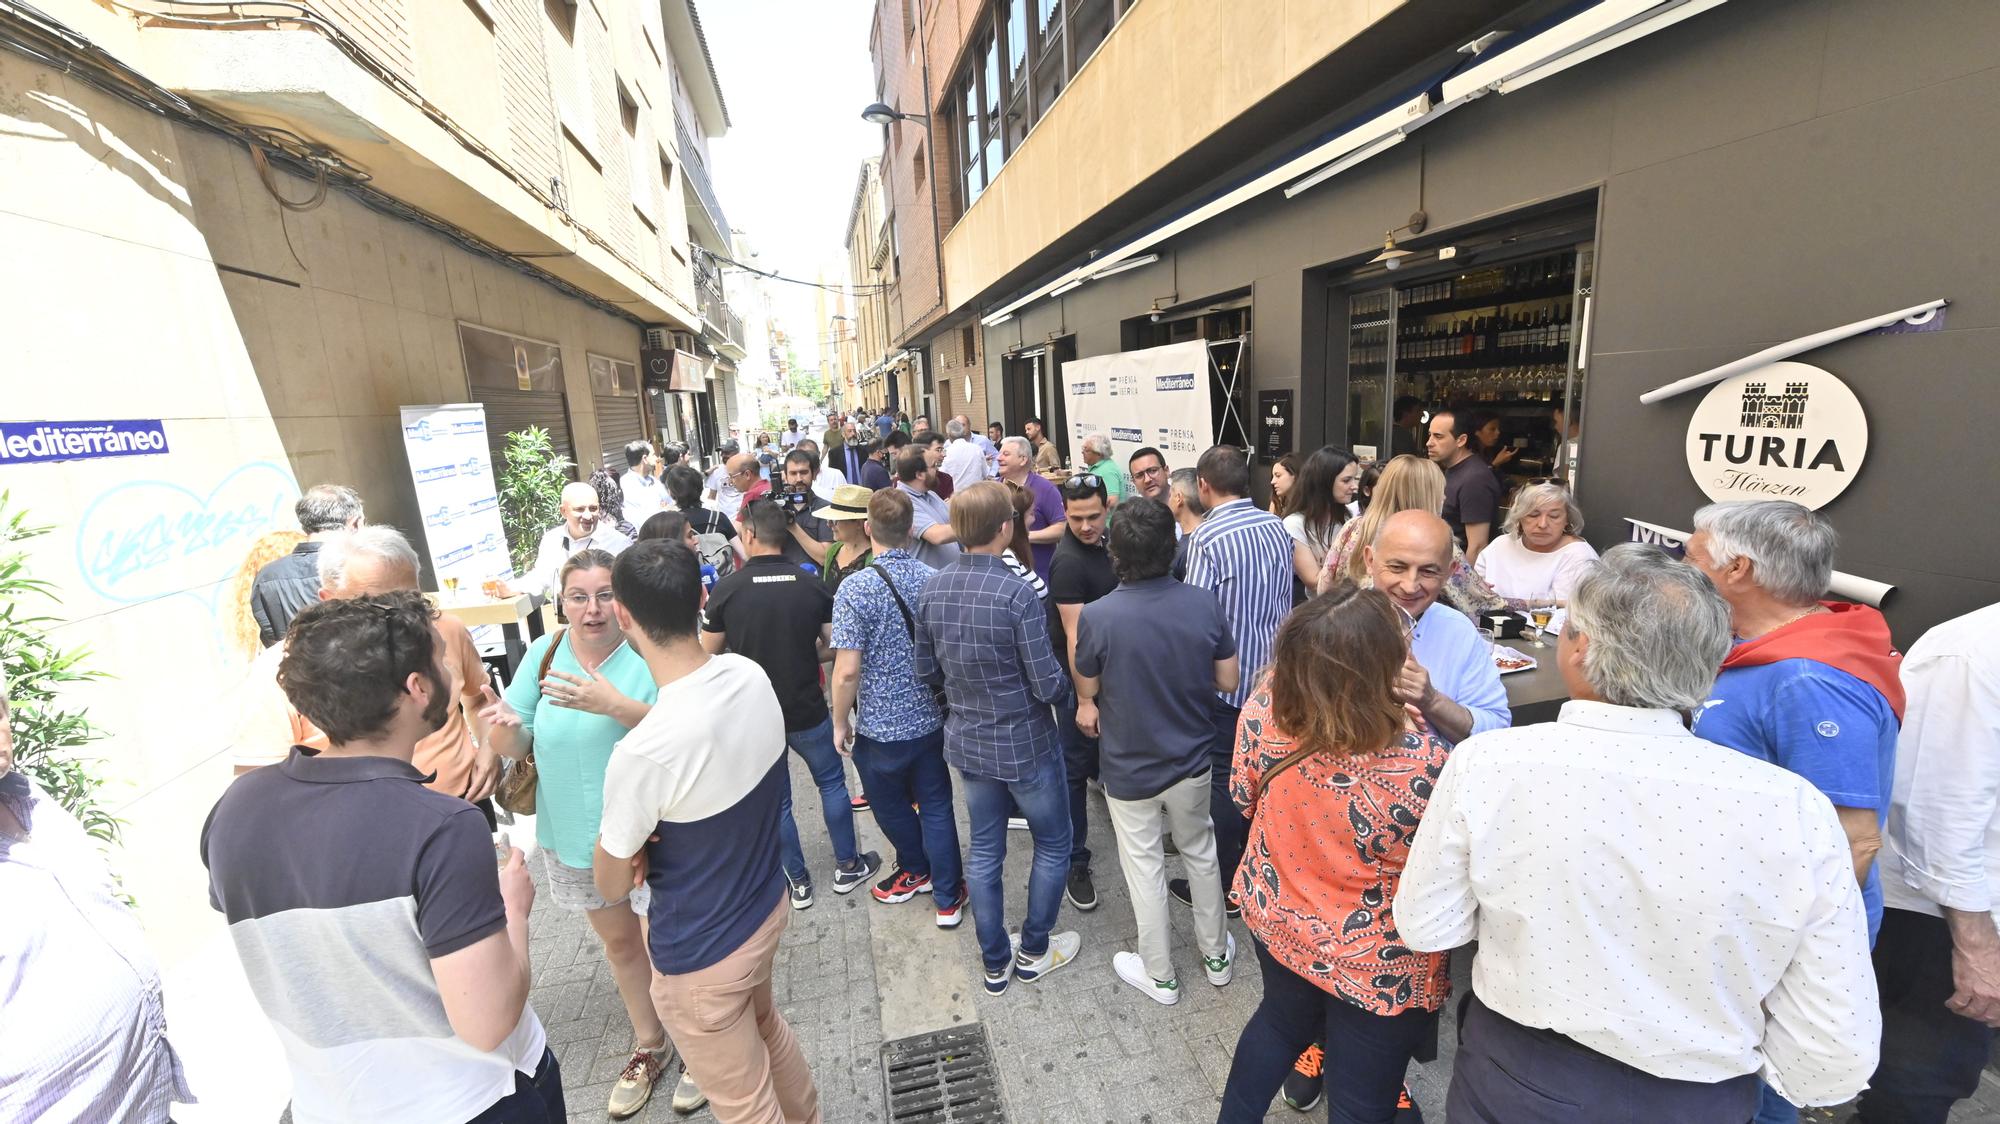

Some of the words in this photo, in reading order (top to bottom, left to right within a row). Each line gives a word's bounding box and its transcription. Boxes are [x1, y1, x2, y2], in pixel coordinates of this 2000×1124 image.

[1170, 429, 1194, 439] PRENSA
[1699, 433, 1845, 472] TURIA
[1713, 469, 1810, 497] Märzen
